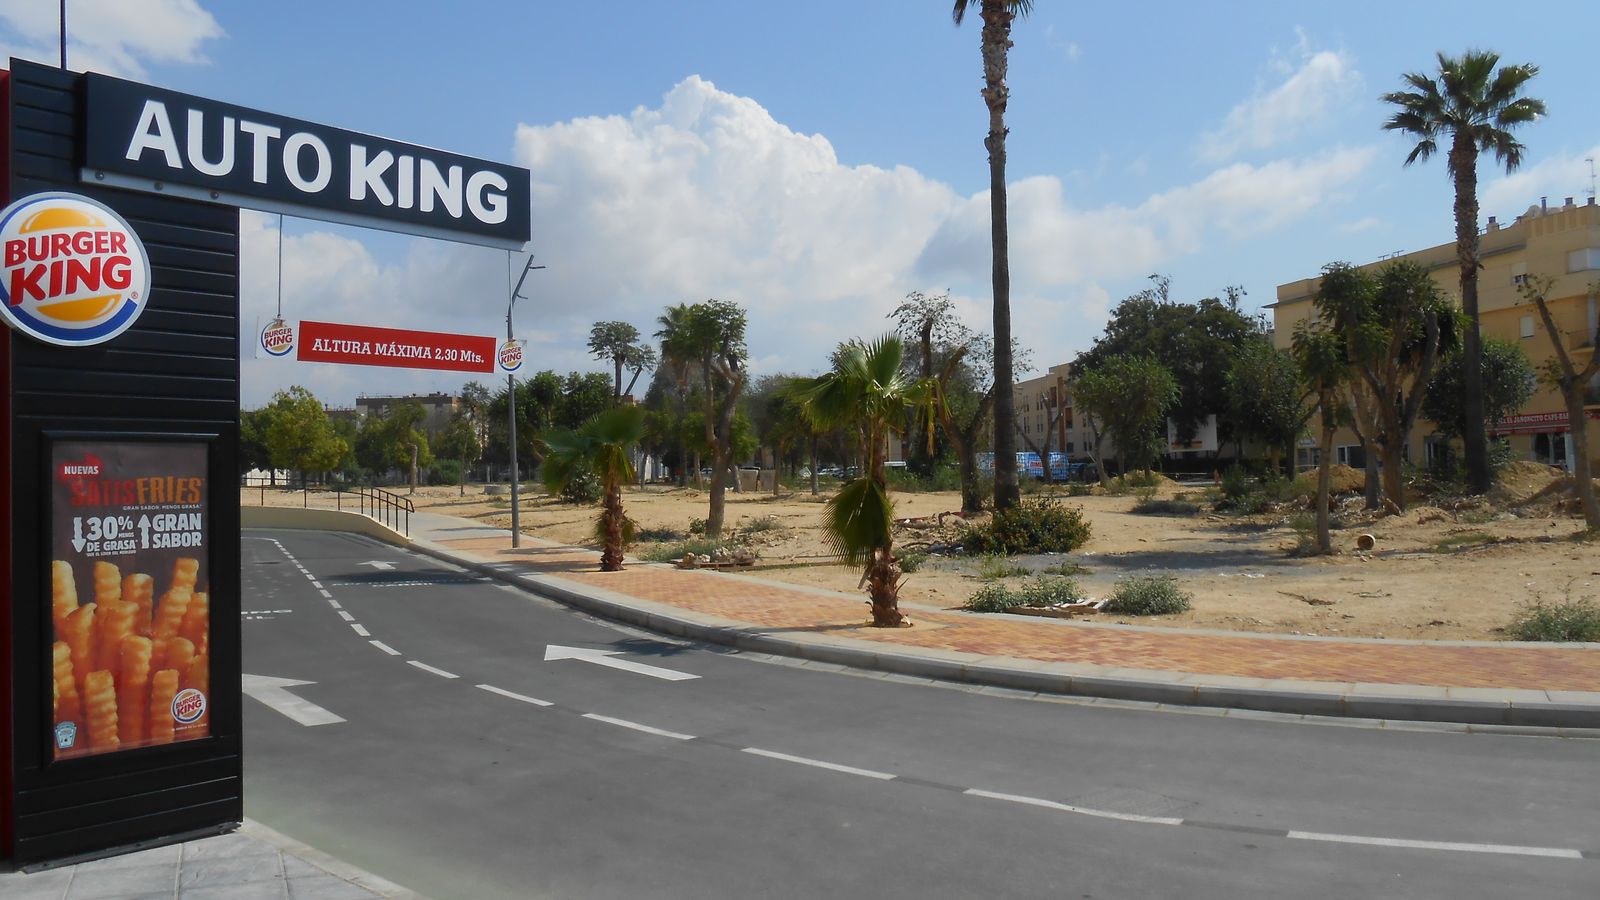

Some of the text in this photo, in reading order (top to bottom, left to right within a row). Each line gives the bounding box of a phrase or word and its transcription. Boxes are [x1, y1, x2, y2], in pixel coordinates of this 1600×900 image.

[125, 99, 509, 225] AUTO KING
[5, 231, 127, 268] BURGER
[10, 255, 132, 306] KING
[264, 328, 292, 340] BURGER
[265, 334, 293, 348] KING
[312, 338, 485, 364] ALTURA MÁXIMA 2,30 Mts.
[501, 353, 521, 364] KING
[64, 466, 99, 475] NUEVAS
[86, 515, 134, 540] 30%
[152, 513, 202, 532] GRAN
[87, 542, 100, 552] DE
[152, 532, 202, 549] SABOR
[176, 694, 201, 709] BURGER
[176, 700, 202, 717] KING
